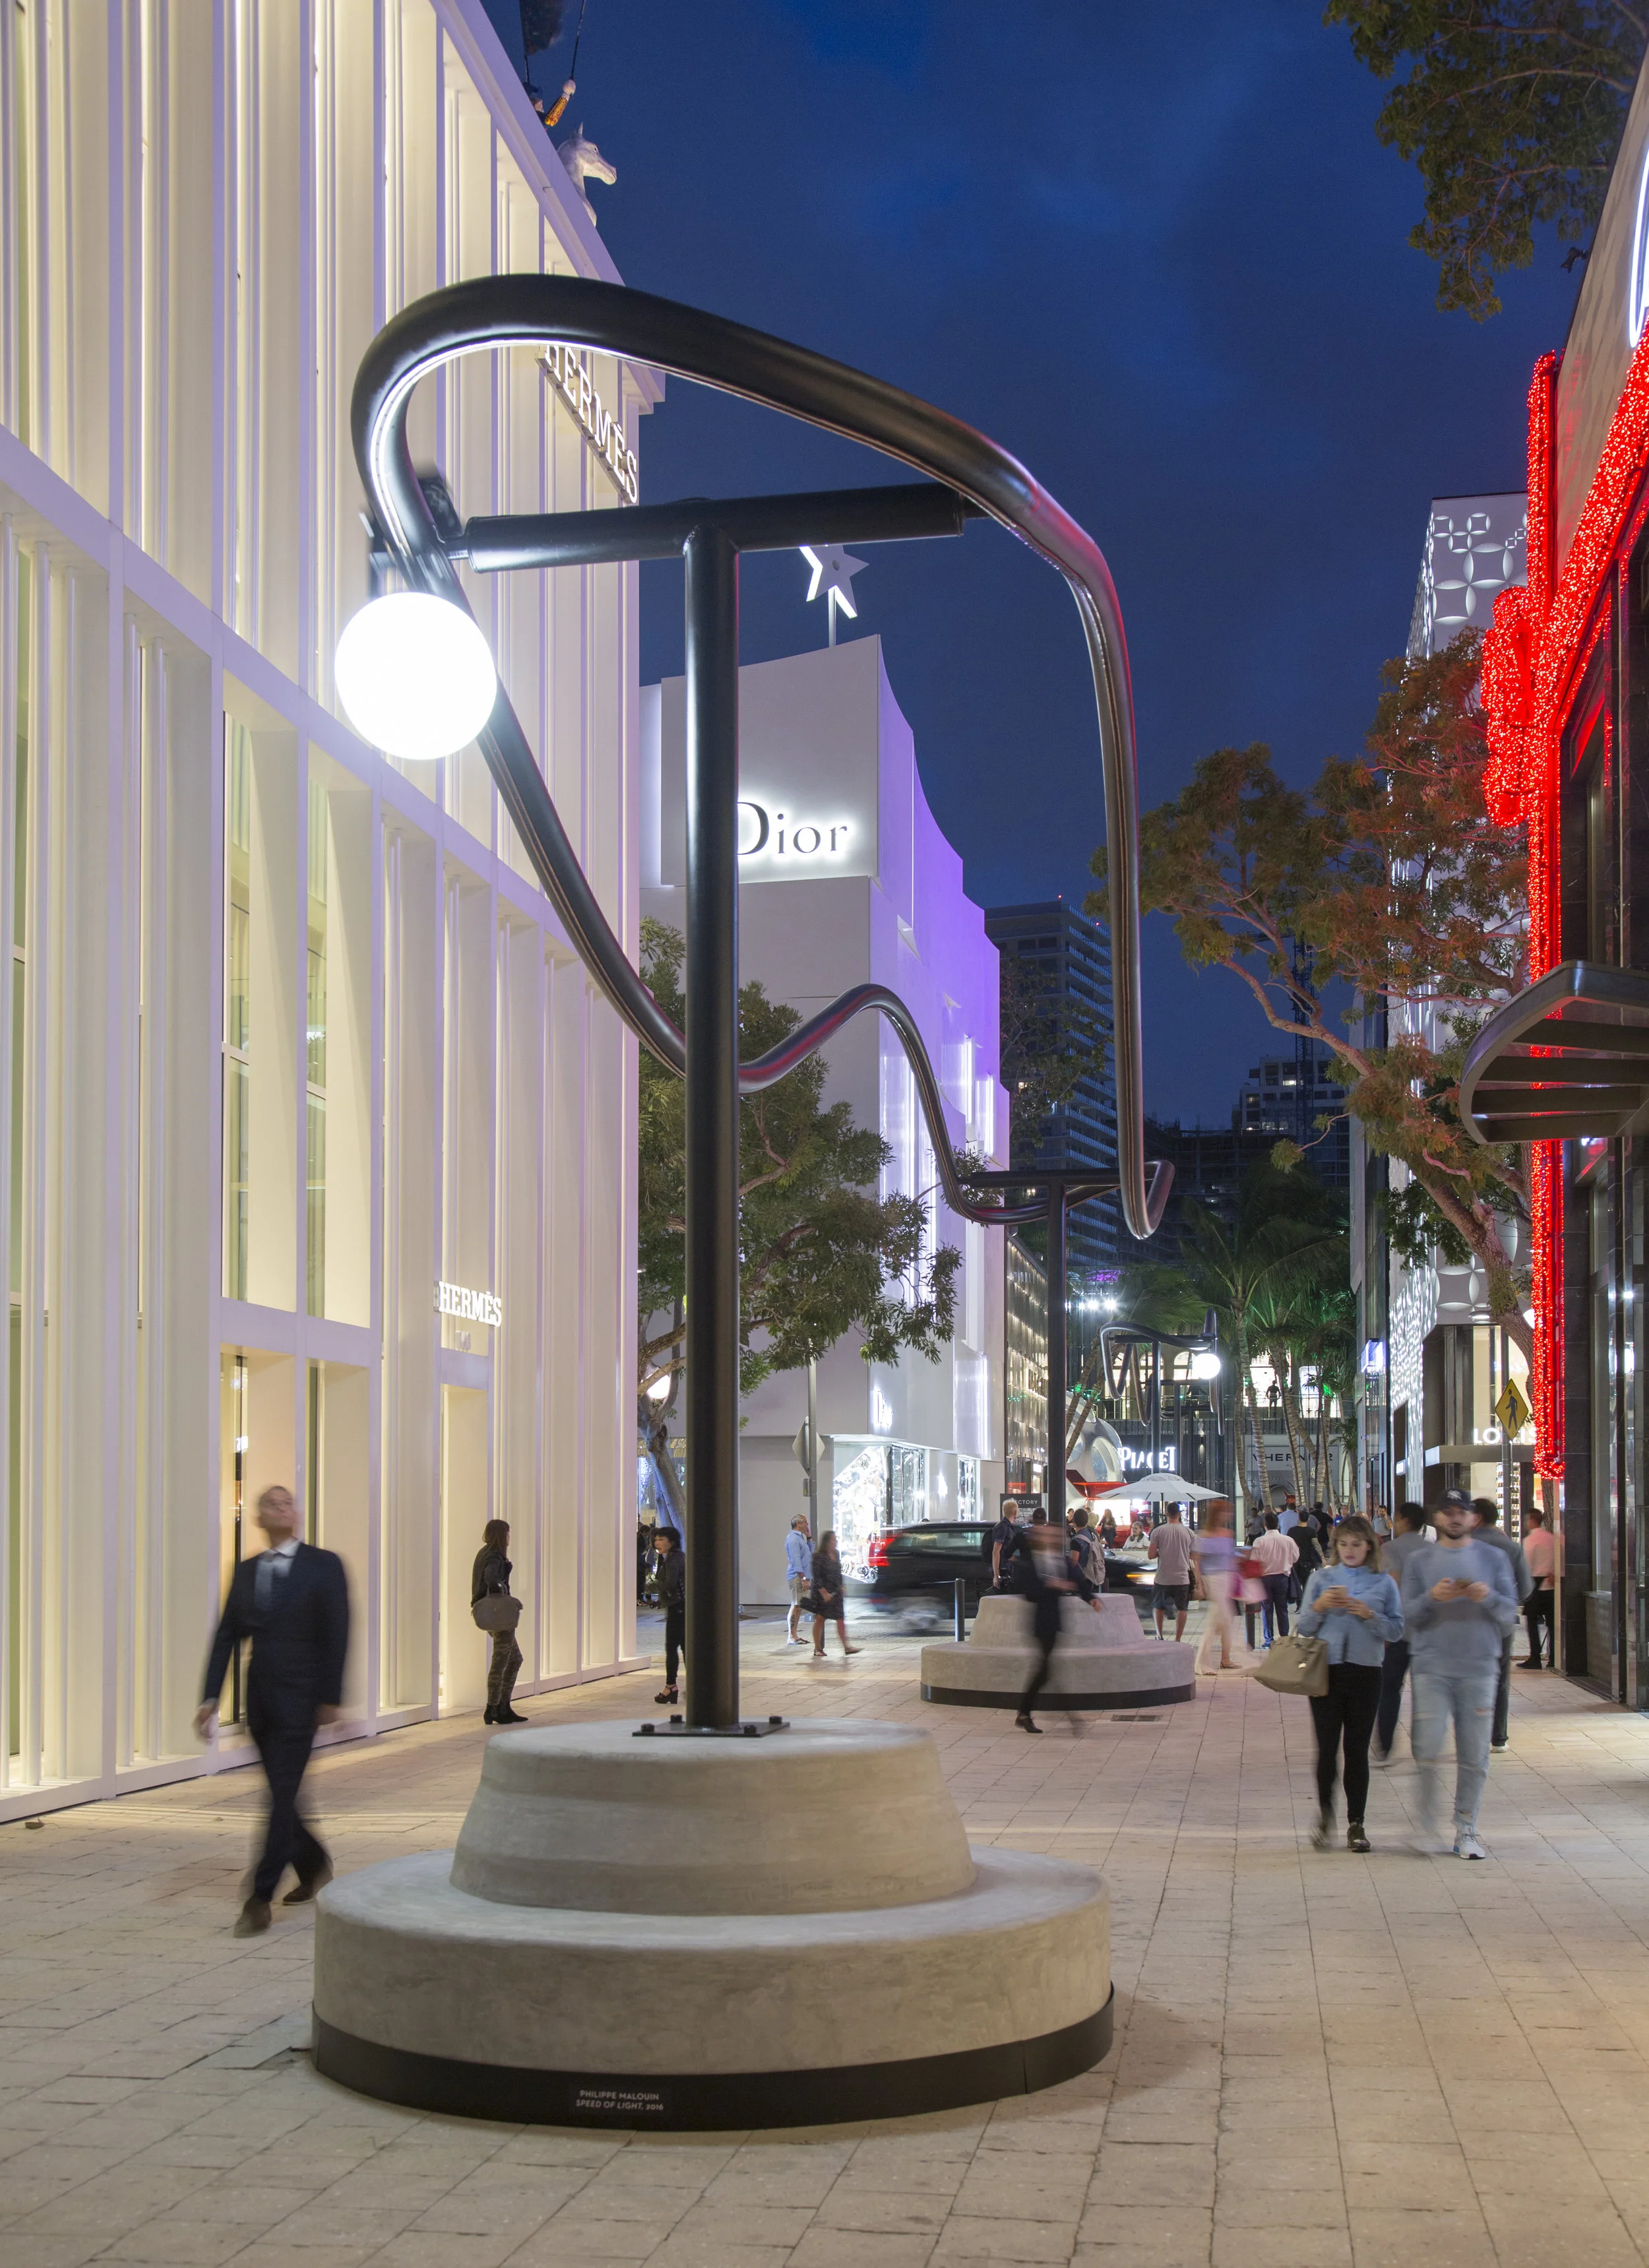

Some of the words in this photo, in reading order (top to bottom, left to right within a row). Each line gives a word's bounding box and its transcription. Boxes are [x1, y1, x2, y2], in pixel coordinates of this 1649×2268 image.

[737, 802, 848, 855] Dior
[439, 1280, 501, 1327] HERMÈS
[1474, 1427, 1537, 1444] LOIS
[580, 2090, 617, 2099] PHILIPPE
[576, 2099, 602, 2108] SPEED
